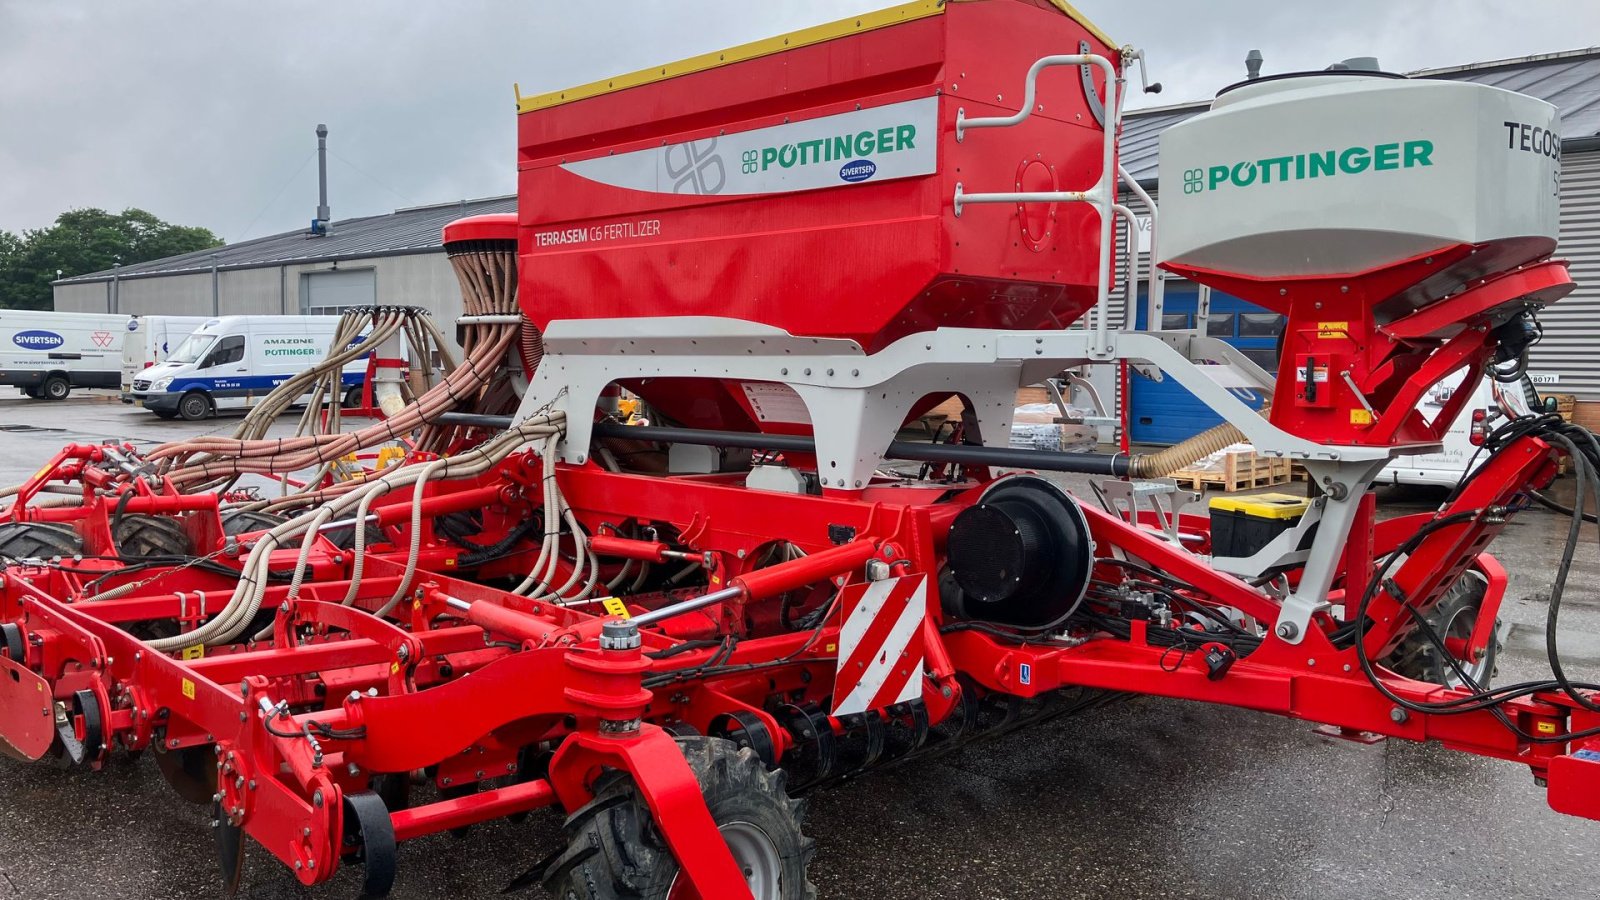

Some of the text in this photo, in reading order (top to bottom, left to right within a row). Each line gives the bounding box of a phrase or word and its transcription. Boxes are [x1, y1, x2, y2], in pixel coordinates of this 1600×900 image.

[841, 164, 875, 177] SIVERTSEN
[535, 219, 661, 246] TERRASEM C6 FERTILIZER
[16, 336, 61, 345] SIVERTSEN
